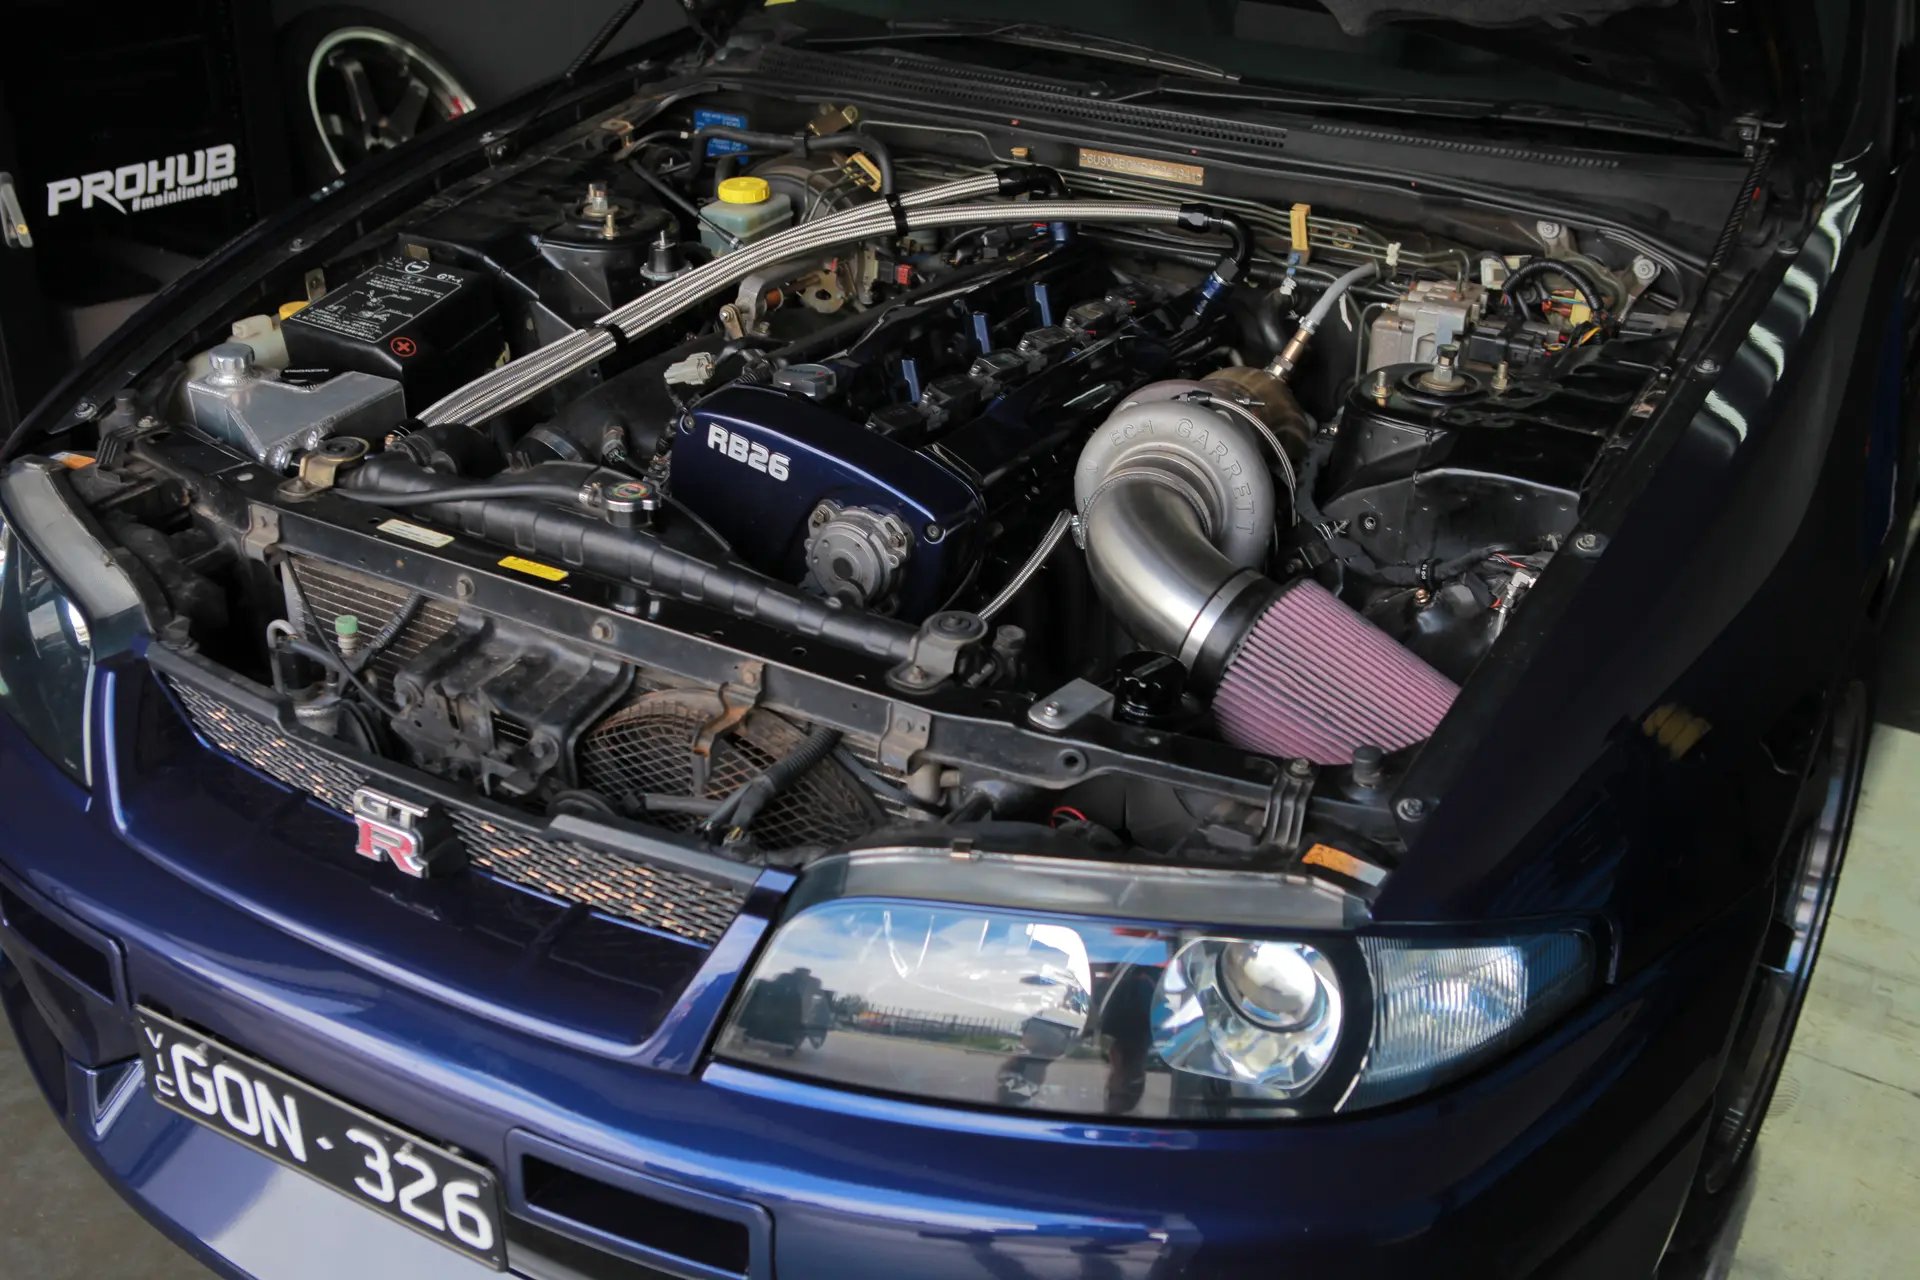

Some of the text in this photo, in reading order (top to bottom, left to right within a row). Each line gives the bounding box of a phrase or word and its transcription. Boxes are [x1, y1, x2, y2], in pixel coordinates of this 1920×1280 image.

[47, 143, 237, 217] PROHUB
[131, 176, 238, 212] #mainlinedyno
[707, 422, 791, 482] RB26
[1175, 417, 1256, 535] GARRETT
[145, 1026, 176, 1097] VIC
[170, 1042, 494, 1250] GON 326
